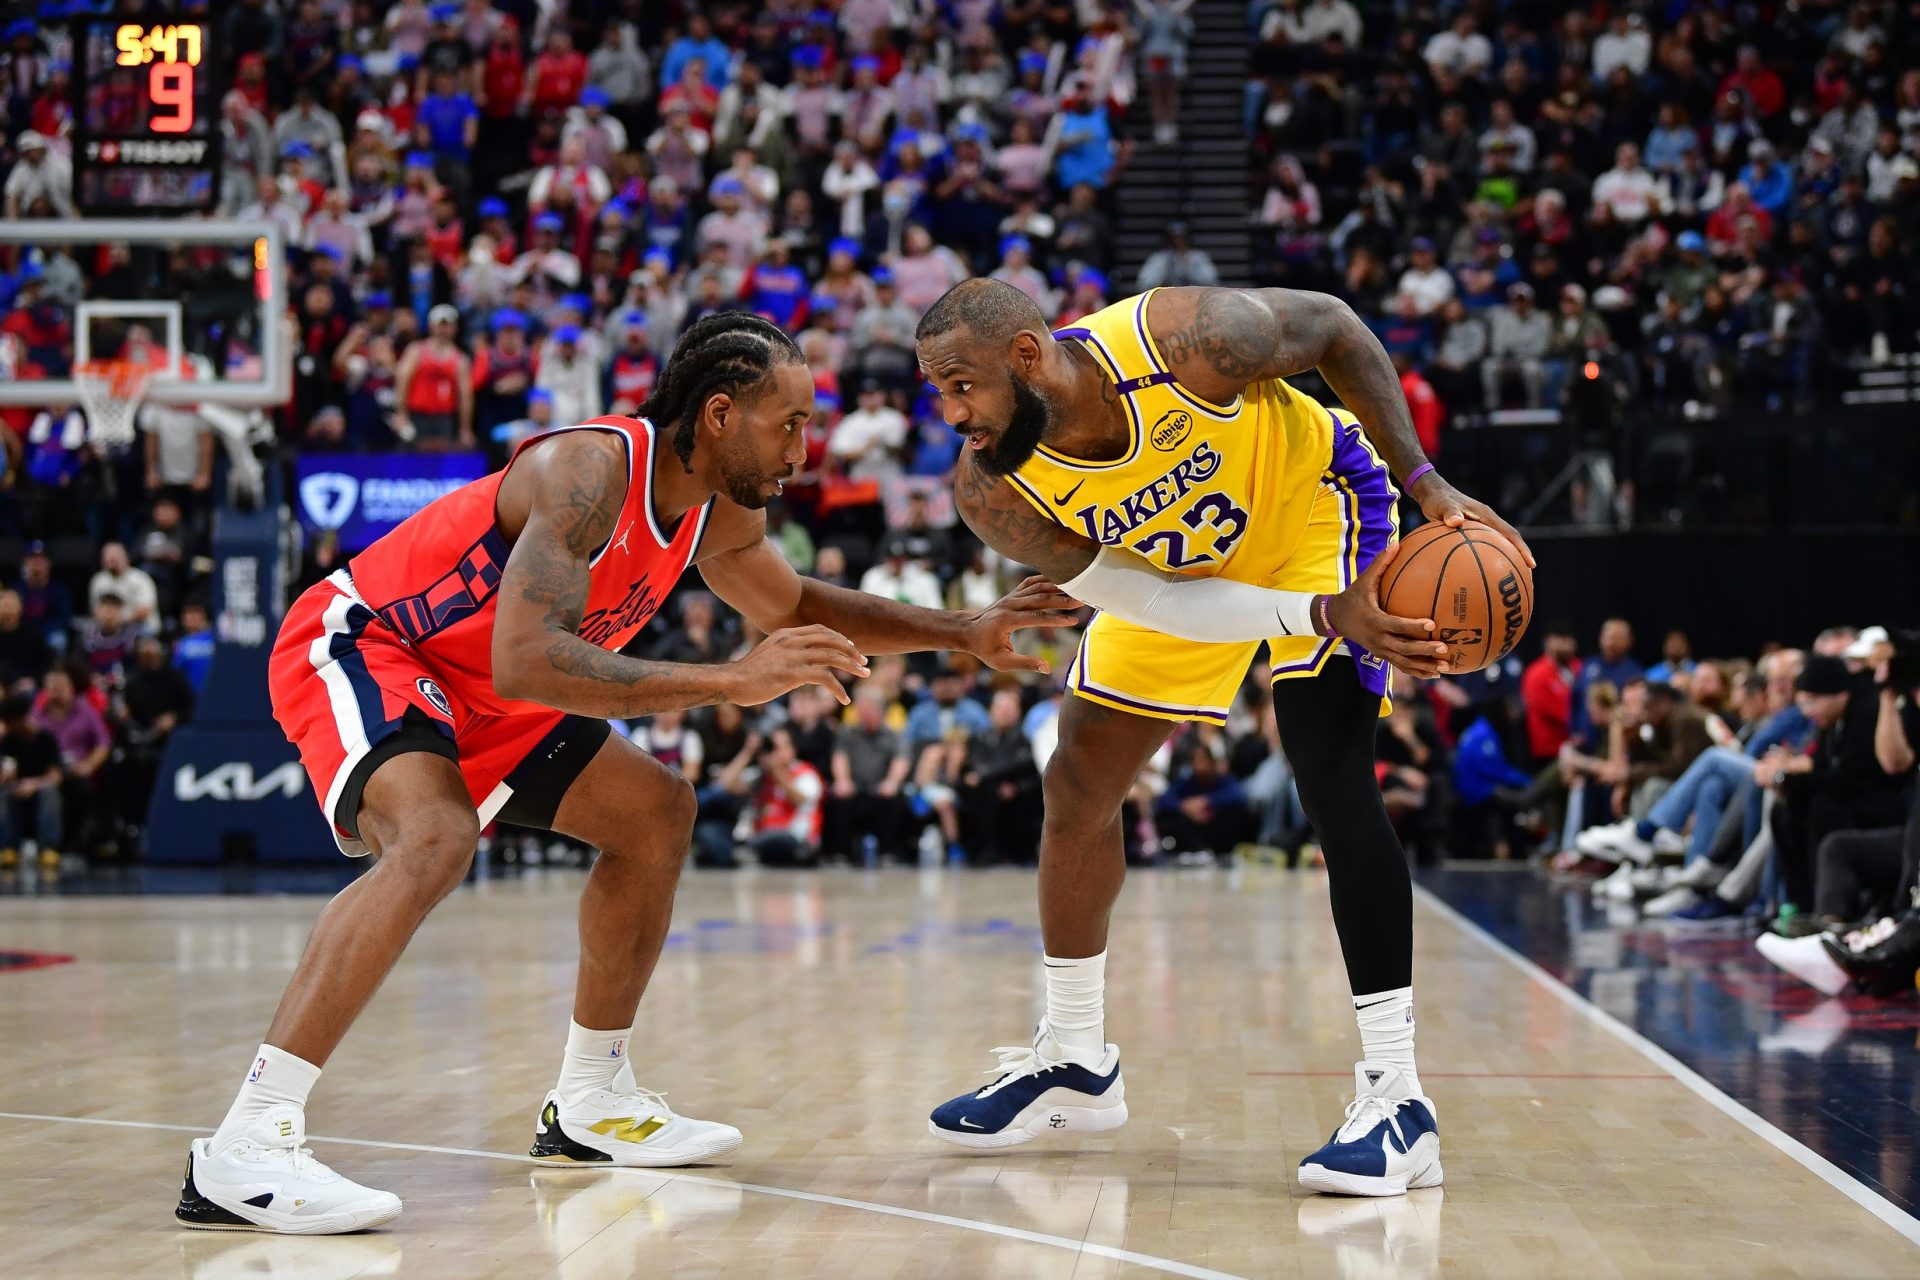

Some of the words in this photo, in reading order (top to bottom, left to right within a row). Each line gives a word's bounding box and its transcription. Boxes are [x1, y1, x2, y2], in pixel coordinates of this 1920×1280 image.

[116, 24, 200, 66] 5:47
[150, 62, 193, 132] 9
[1138, 376, 1152, 388] 44
[1154, 414, 1188, 446] bibigo
[1075, 440, 1222, 546] LAKERS
[1132, 490, 1249, 568] 23
